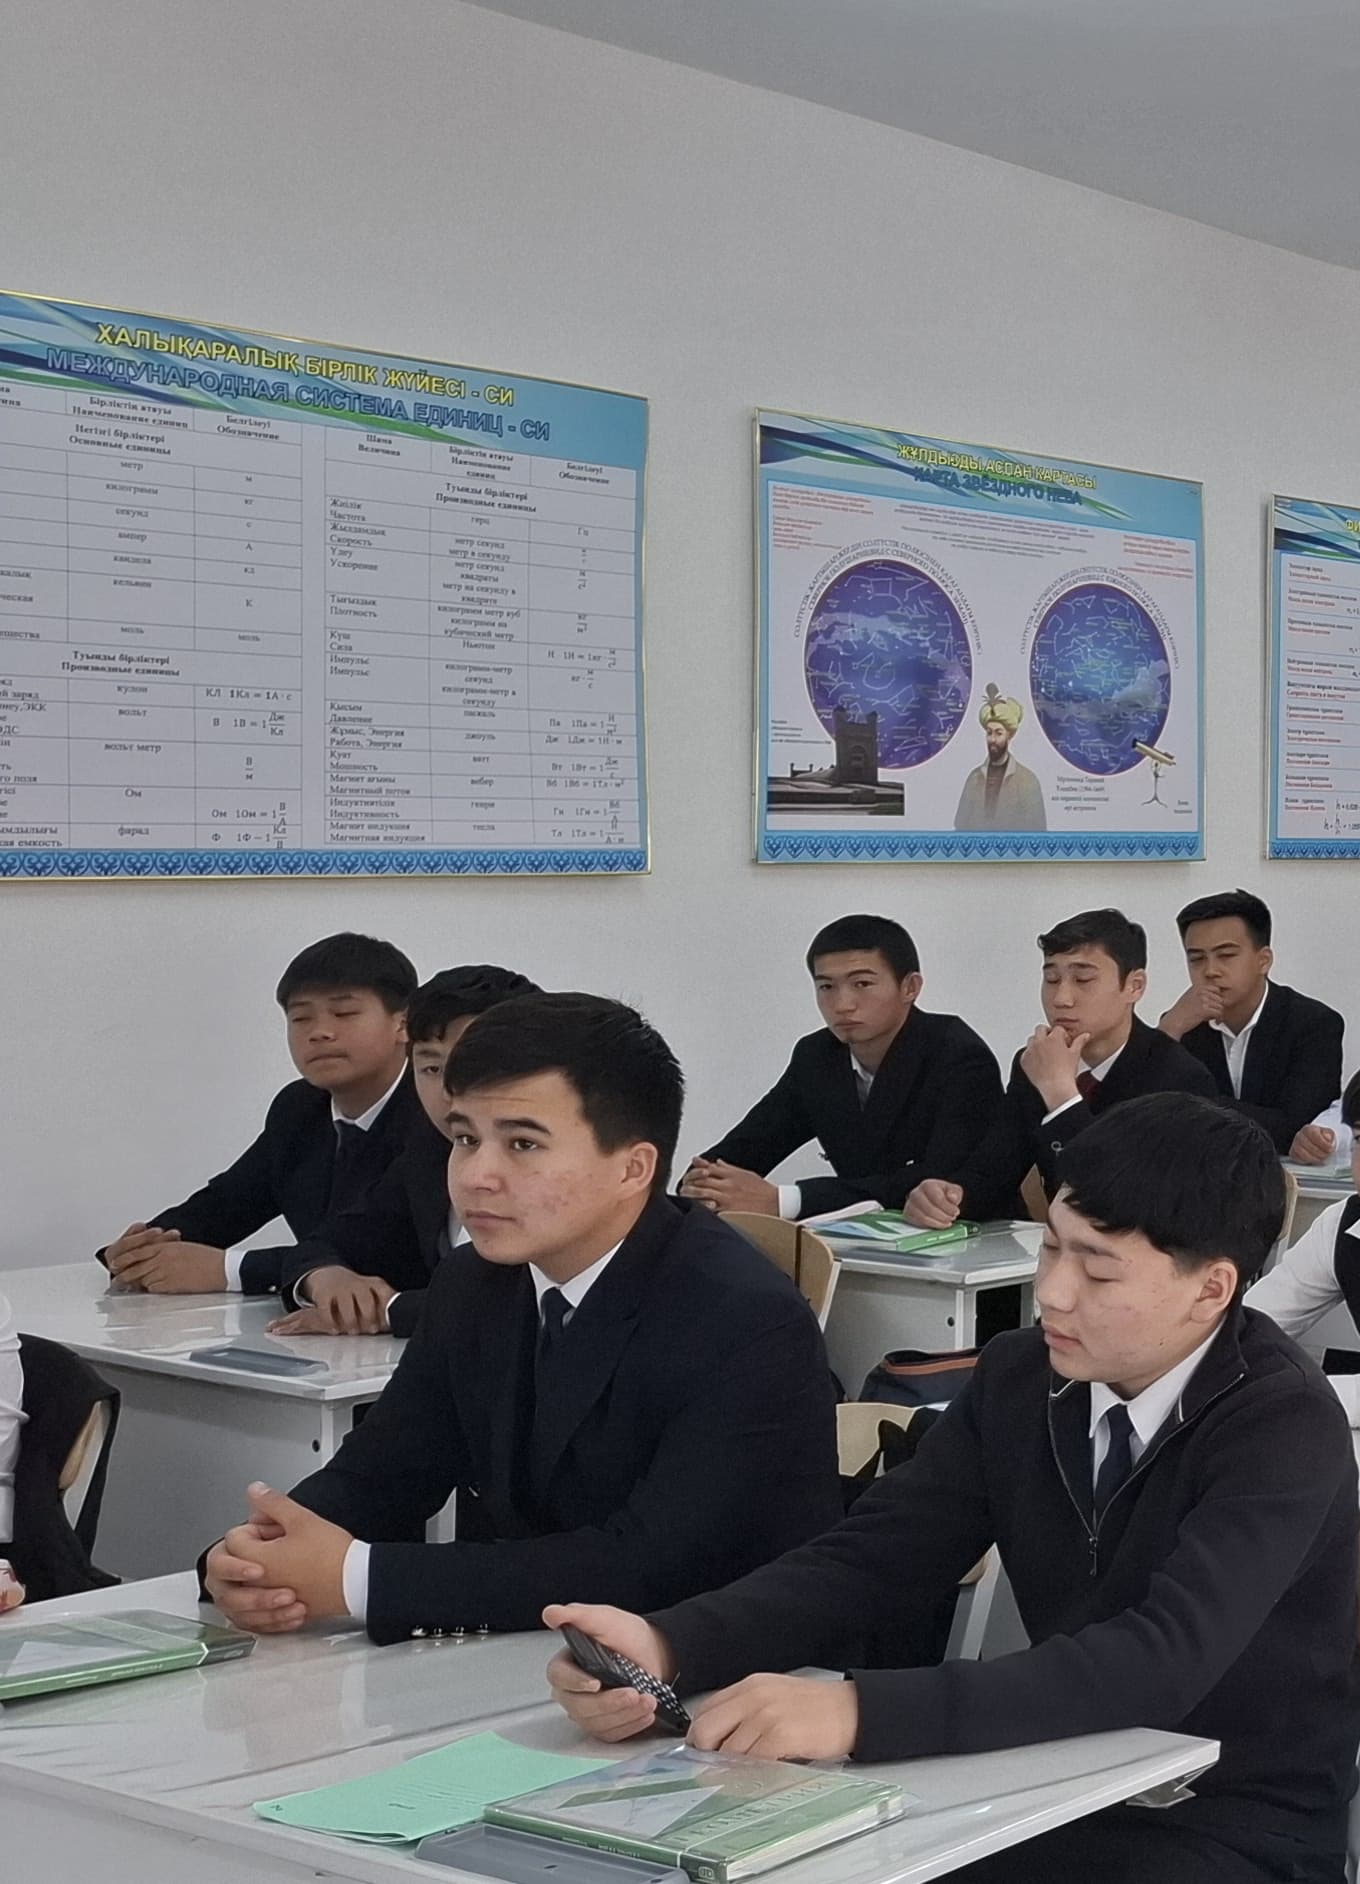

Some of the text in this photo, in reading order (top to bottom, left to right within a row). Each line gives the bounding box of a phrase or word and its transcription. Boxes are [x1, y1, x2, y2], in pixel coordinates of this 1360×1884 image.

[96, 322, 515, 407] ХАЛЫҚАРАЛЫҚ БІРЛІК ЖҮЙЕСІ СИ
[47, 348, 550, 441] МЕЖДУНАРОДНАЯ СИСТЕМА ЕДИНИЦ СИ
[69, 434, 123, 450] Основные
[120, 460, 144, 471] метр
